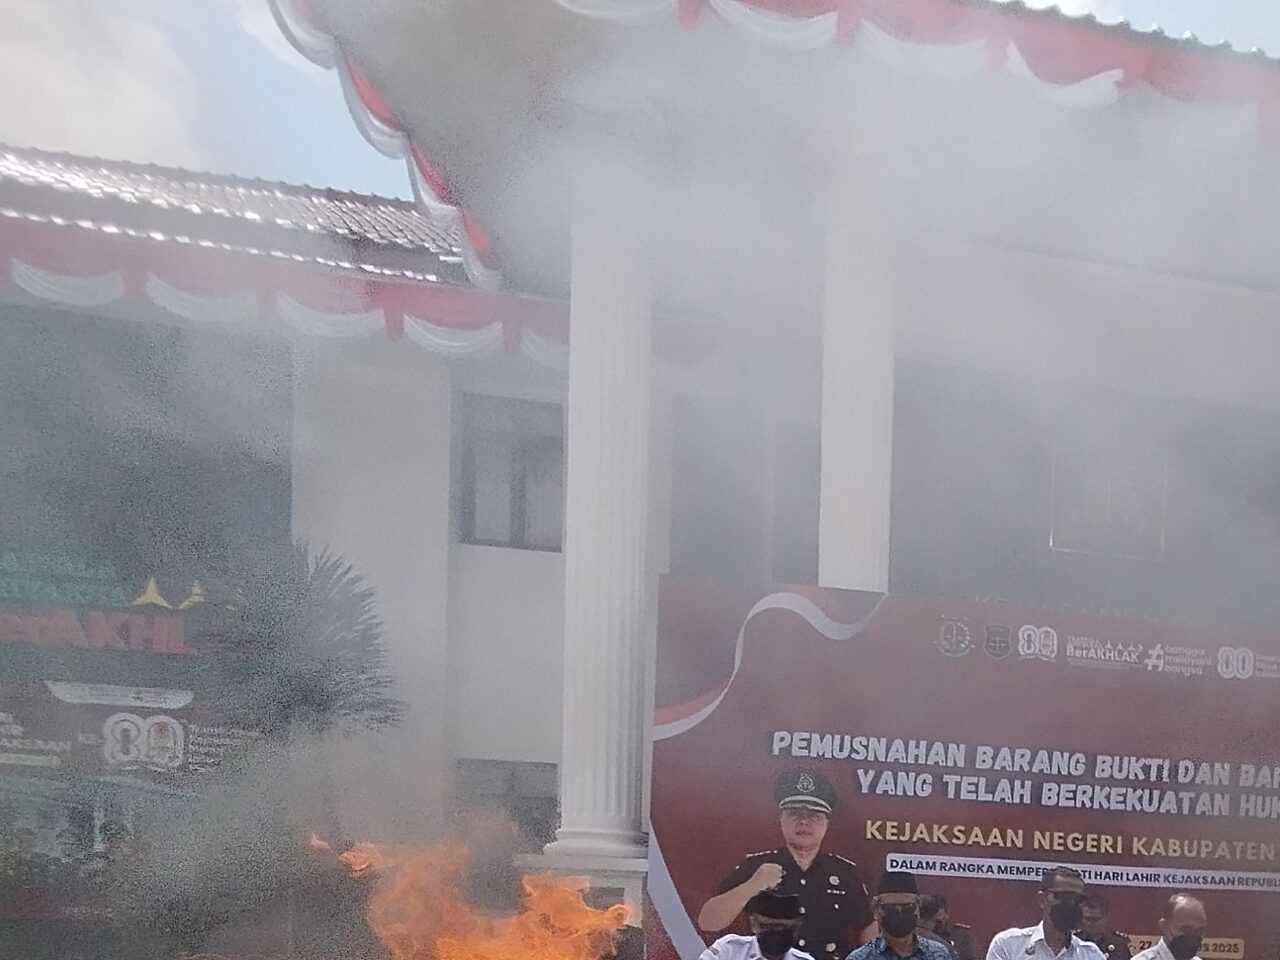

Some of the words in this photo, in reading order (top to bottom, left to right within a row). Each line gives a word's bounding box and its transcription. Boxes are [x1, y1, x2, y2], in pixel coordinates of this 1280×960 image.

[1066, 643, 1139, 663] BerAKHLAK
[772, 731, 966, 768] PEMUSNAHAN
[975, 746, 1086, 777] BARANG
[1094, 755, 1171, 783] BUKTI
[1177, 759, 1230, 787] DAN
[857, 768, 933, 797] YANG
[943, 774, 1032, 804] TELAH
[1041, 782, 1230, 816] BERKEKUATAN
[866, 819, 1024, 849] KEJAKSAAN
[1033, 830, 1122, 854] NEGERI
[1132, 836, 1274, 861] KABUPATEN
[889, 858, 937, 871] DALAM
[939, 862, 995, 875] RANGKA
[1094, 870, 1123, 882] HARI
[1126, 872, 1161, 883] LAHIR
[1163, 874, 1235, 886] KEJAKSAAN
[1213, 943, 1240, 953] 2025
